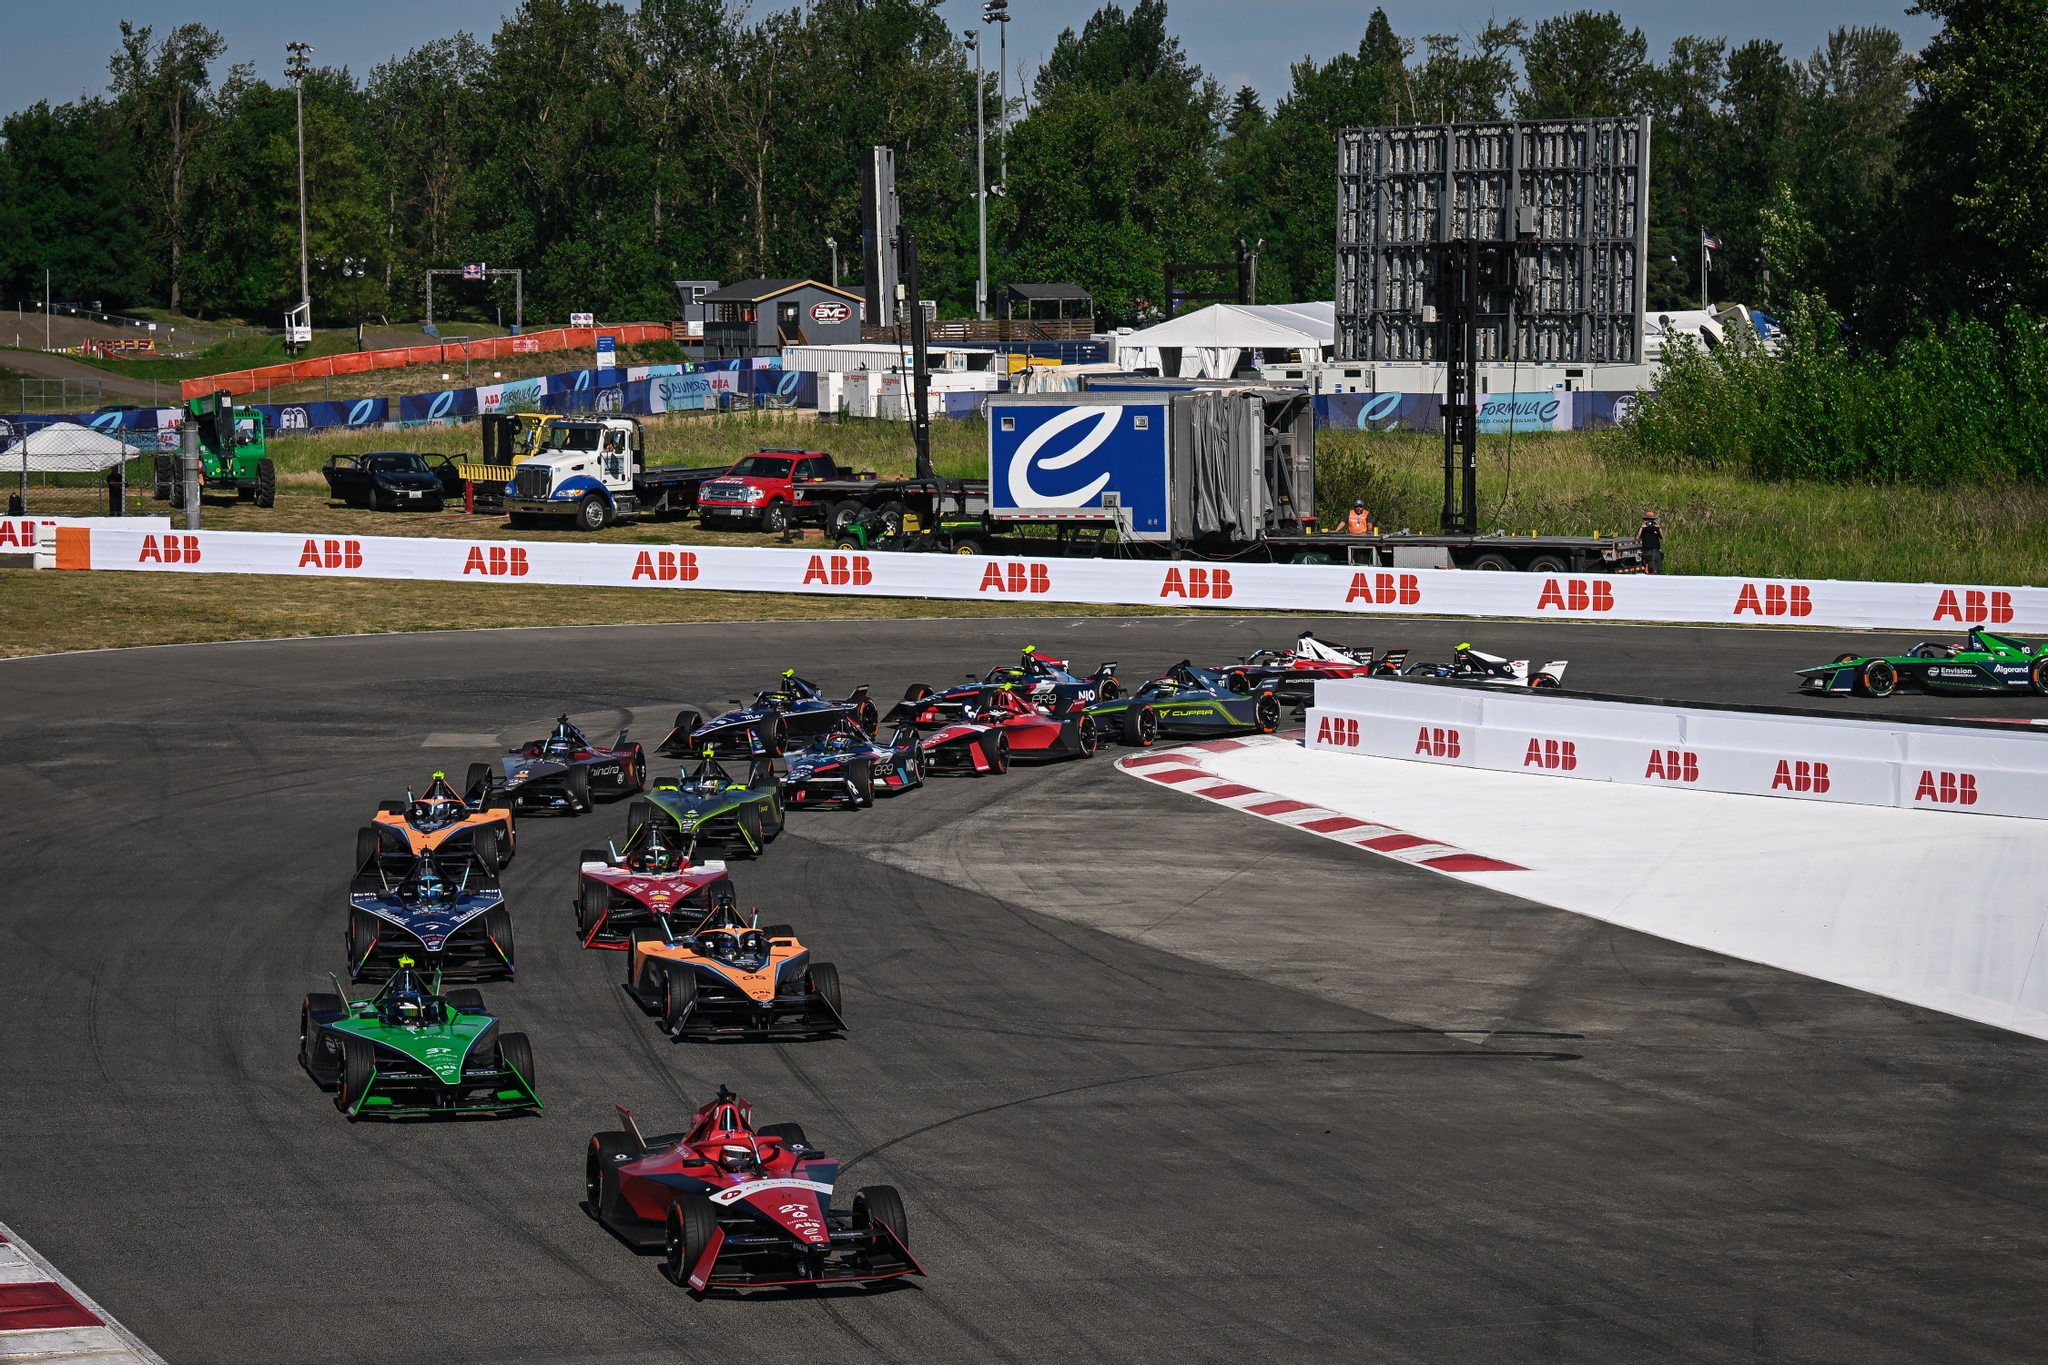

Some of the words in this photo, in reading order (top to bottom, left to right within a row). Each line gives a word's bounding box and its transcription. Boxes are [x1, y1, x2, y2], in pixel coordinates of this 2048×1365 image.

[815, 308, 846, 318] BMC
[485, 394, 500, 406] ABB
[500, 387, 532, 404] FORMULA
[1480, 401, 1540, 416] FORMULA
[0, 521, 57, 547] AB
[140, 536, 200, 563] ABB
[300, 540, 362, 568] ABB
[464, 547, 528, 576] ABB
[632, 552, 698, 580] ABB
[804, 556, 872, 585] ABB
[980, 563, 1050, 592] ABB
[1161, 568, 1232, 598] ABB
[1346, 573, 1420, 604] ABB
[1538, 580, 1614, 611] ABB
[1734, 584, 1812, 616] ABB
[1933, 590, 2013, 623] ABB
[1994, 664, 2029, 675] Algorand
[1078, 690, 1095, 702] NIO
[1172, 709, 1214, 717] CUPRA
[1318, 717, 1359, 747] ABB
[1417, 728, 1460, 758] ABB
[1525, 739, 1576, 770] ABB
[1646, 750, 1699, 782] ABB
[1772, 760, 1830, 793] ABB
[1916, 771, 1977, 805] ABB
[795, 1222, 821, 1230] ABB
